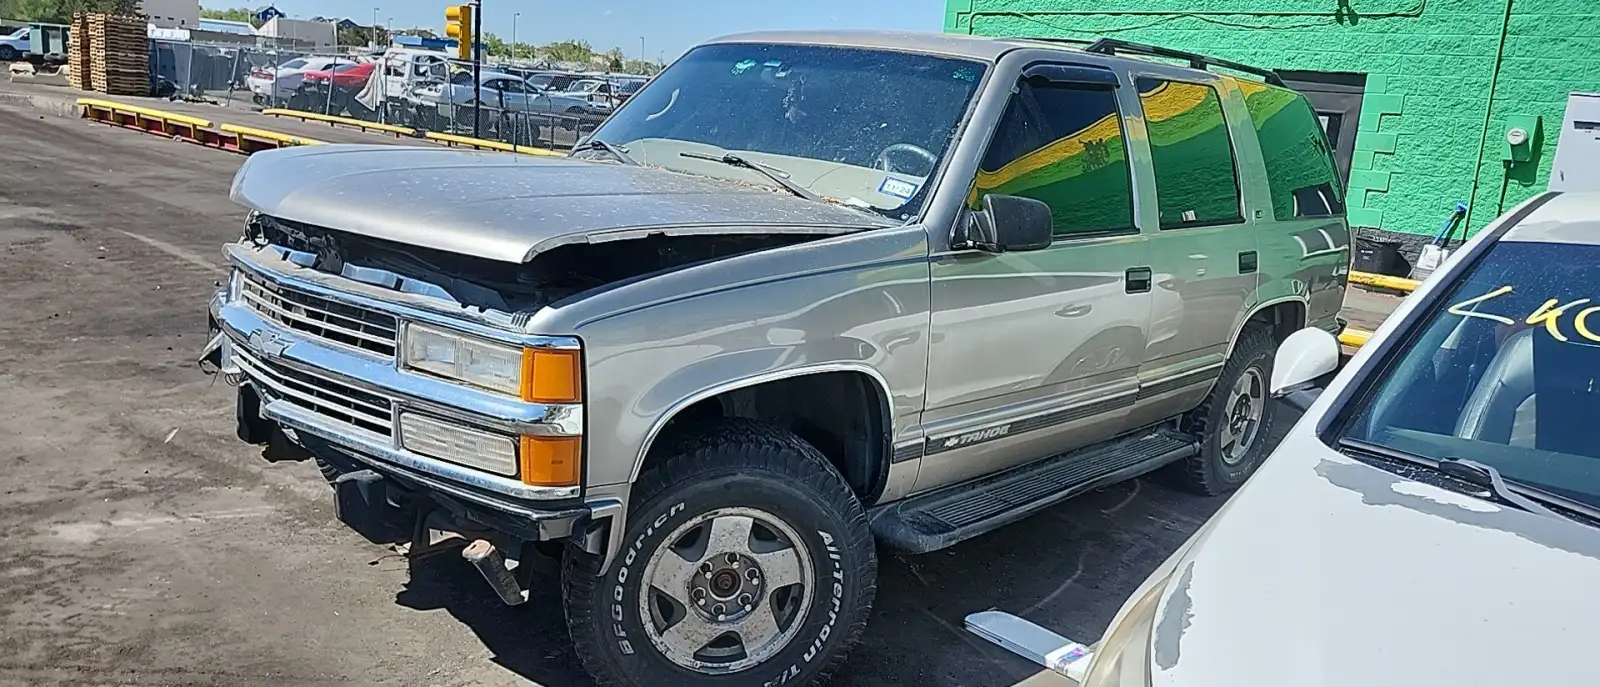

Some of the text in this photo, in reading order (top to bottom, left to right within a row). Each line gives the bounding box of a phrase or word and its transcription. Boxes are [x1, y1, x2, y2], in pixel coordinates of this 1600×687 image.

[960, 424, 1011, 444] TAHOE
[611, 502, 685, 655] BFGoodrich
[803, 530, 844, 662] All-Terrain
